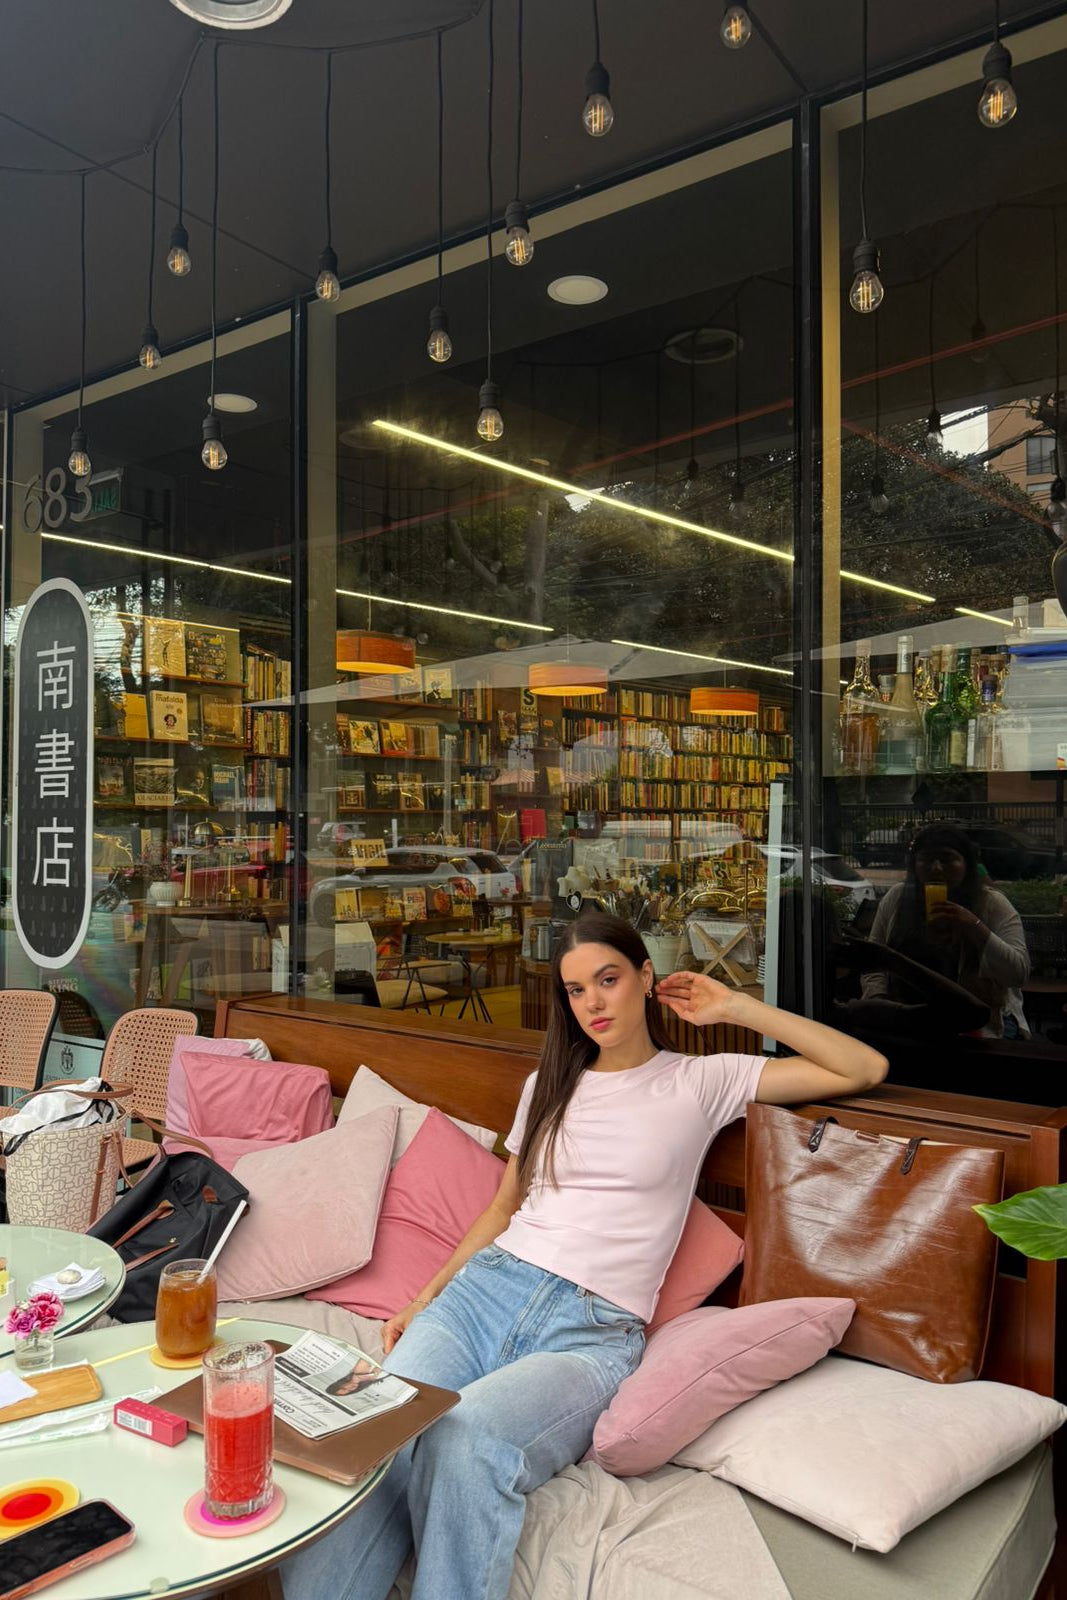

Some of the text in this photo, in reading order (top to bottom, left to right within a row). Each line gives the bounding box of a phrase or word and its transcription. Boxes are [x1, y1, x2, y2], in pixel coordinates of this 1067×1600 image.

[32, 640, 76, 888] 南書店
[50, 983, 78, 992] KING
